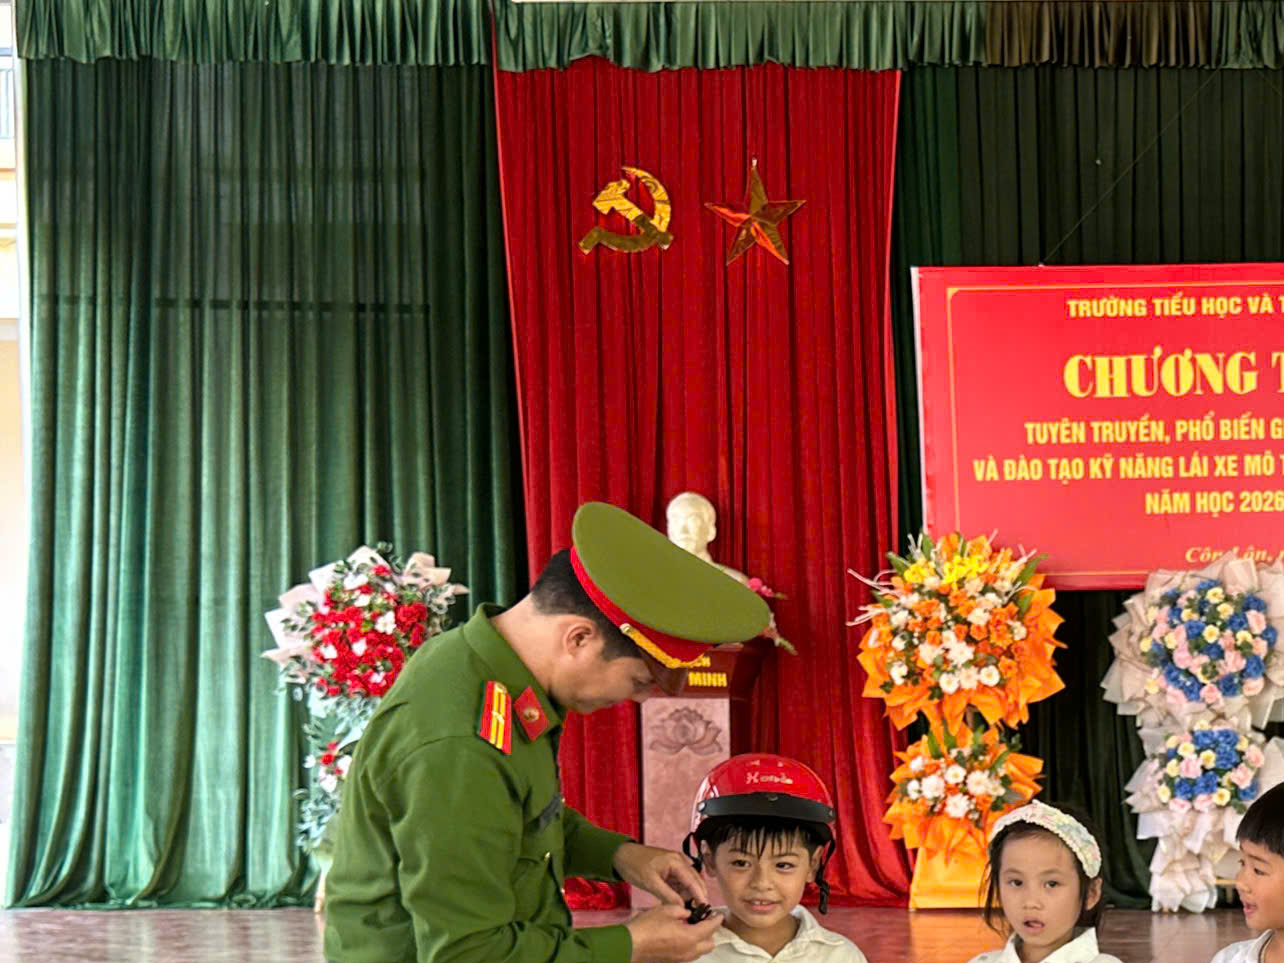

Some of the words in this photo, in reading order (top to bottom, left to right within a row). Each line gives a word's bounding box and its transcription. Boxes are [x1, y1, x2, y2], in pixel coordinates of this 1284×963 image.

[1201, 296, 1243, 319] HỌC
[1247, 292, 1274, 314] VÀ
[1063, 345, 1259, 398] CHƯƠNG
[1024, 416, 1086, 445] TUYÊN
[1219, 411, 1265, 441] BIẾN
[972, 453, 1000, 482] VÀ
[1003, 453, 1044, 481] ĐÀO
[1047, 457, 1085, 485] TẠO
[1118, 452, 1175, 479] NĂNG
[1178, 450, 1209, 478] LÁI
[1214, 454, 1239, 478] XE
[1243, 450, 1276, 477] MÔ
[1145, 487, 1191, 515] NĂM
[1195, 490, 1235, 518] HỌC
[688, 671, 728, 687] MINH
